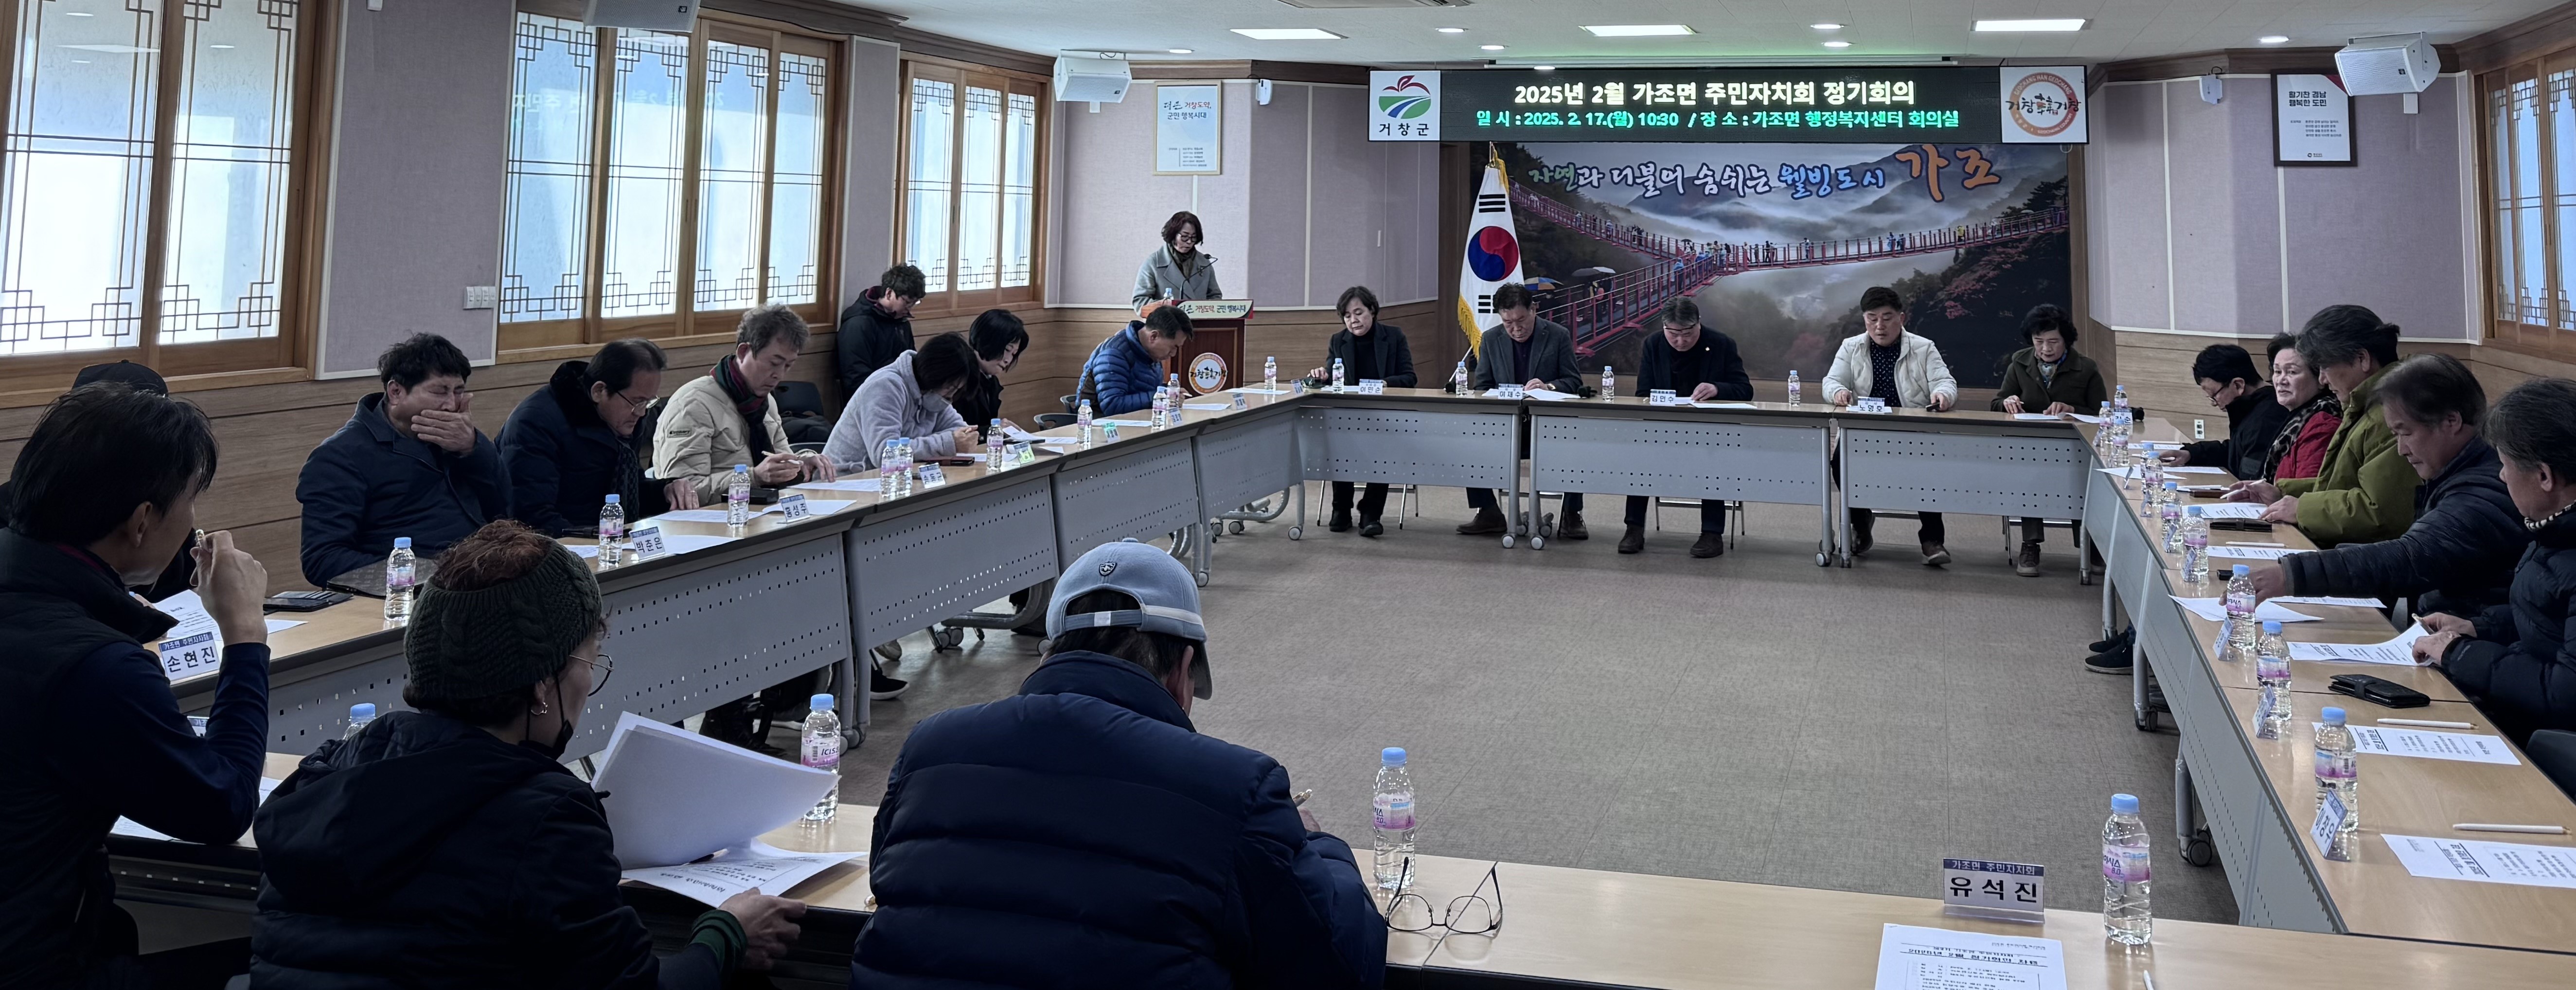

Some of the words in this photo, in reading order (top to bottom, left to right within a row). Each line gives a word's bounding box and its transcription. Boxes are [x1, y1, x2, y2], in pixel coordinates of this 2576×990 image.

[1514, 82, 1583, 105] 2025년
[1591, 82, 1624, 105] 2월
[1632, 82, 1696, 106] 가조면
[1705, 81, 1815, 106] 주민자치회
[1823, 81, 1914, 105] 정기회의
[1167, 112, 1180, 120] 군민
[1638, 112, 1679, 126] 10:30
[1752, 110, 1800, 128] 가조면
[1805, 110, 1903, 128] 행정복지센터
[1908, 110, 1959, 128] 회의실
[1529, 162, 1604, 191] 자연과
[1611, 162, 1685, 198] 더불어
[1693, 163, 1772, 198] 숨쉬는
[1896, 143, 2002, 202] 가조
[1950, 877, 2037, 903] 유석진
